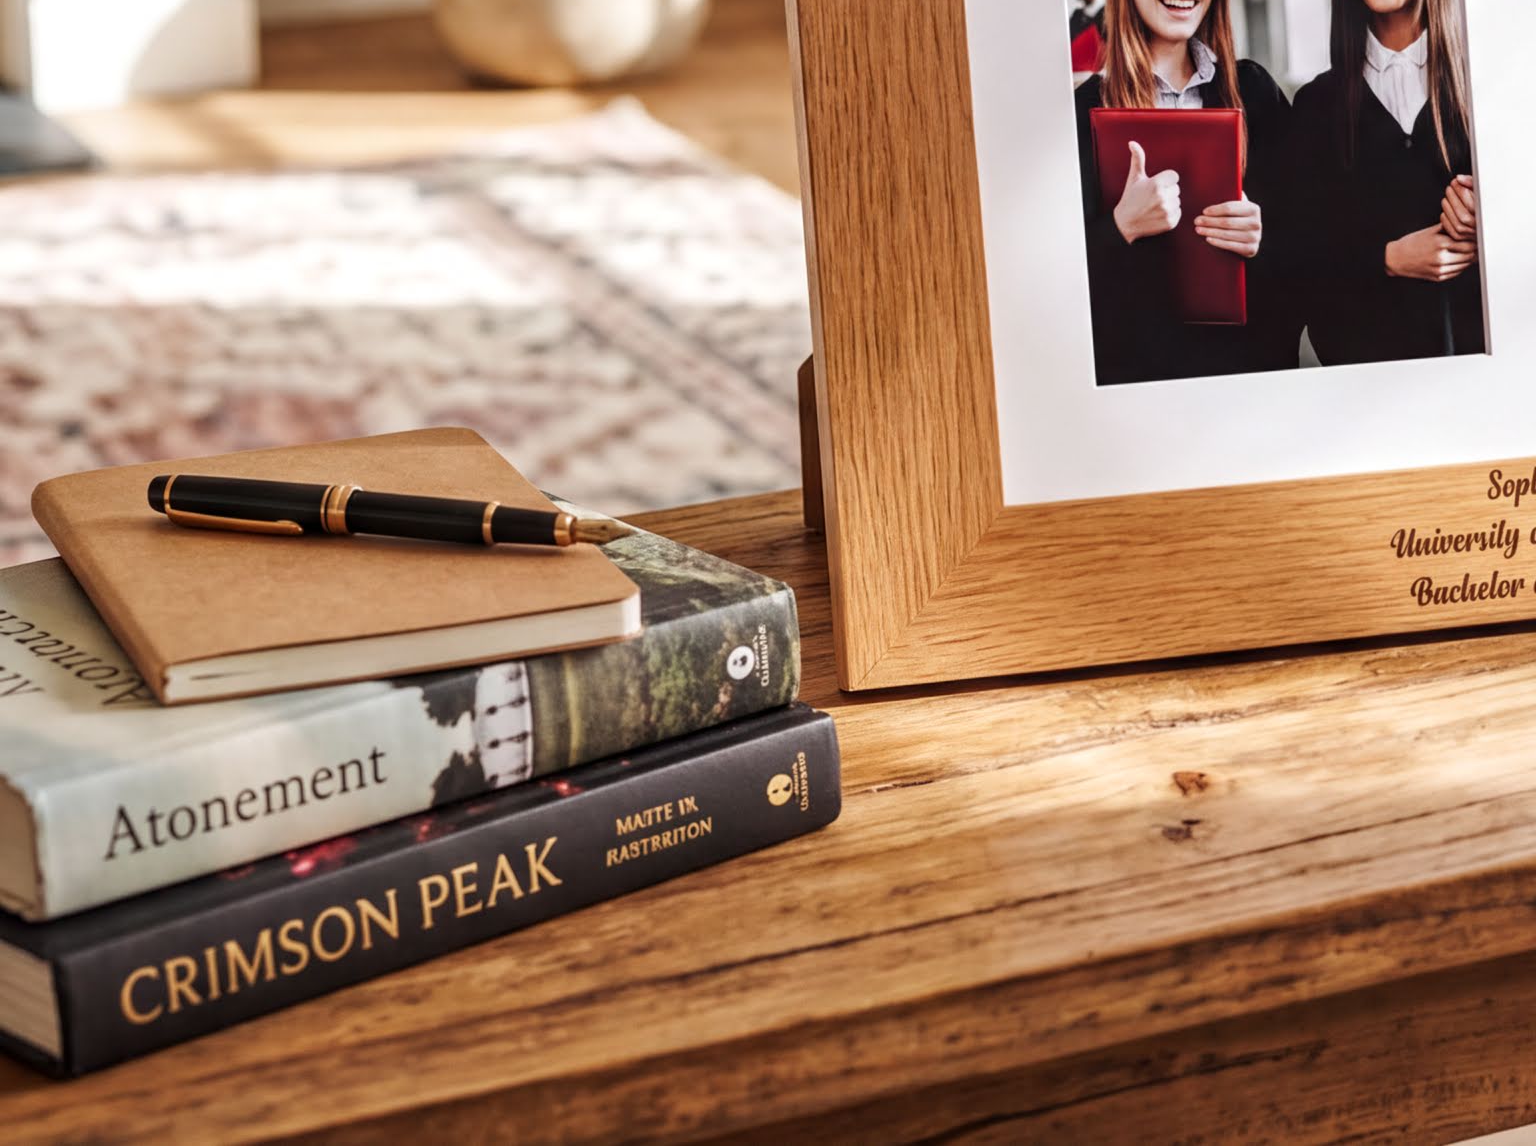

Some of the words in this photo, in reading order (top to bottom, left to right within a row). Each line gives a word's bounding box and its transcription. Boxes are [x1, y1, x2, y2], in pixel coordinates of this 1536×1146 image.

[1390, 519, 1520, 559] University
[1410, 569, 1525, 607] Bachelor
[104, 746, 388, 860] Atonement
[119, 889, 400, 1025] CRIMSON
[417, 836, 563, 929] PEAK
